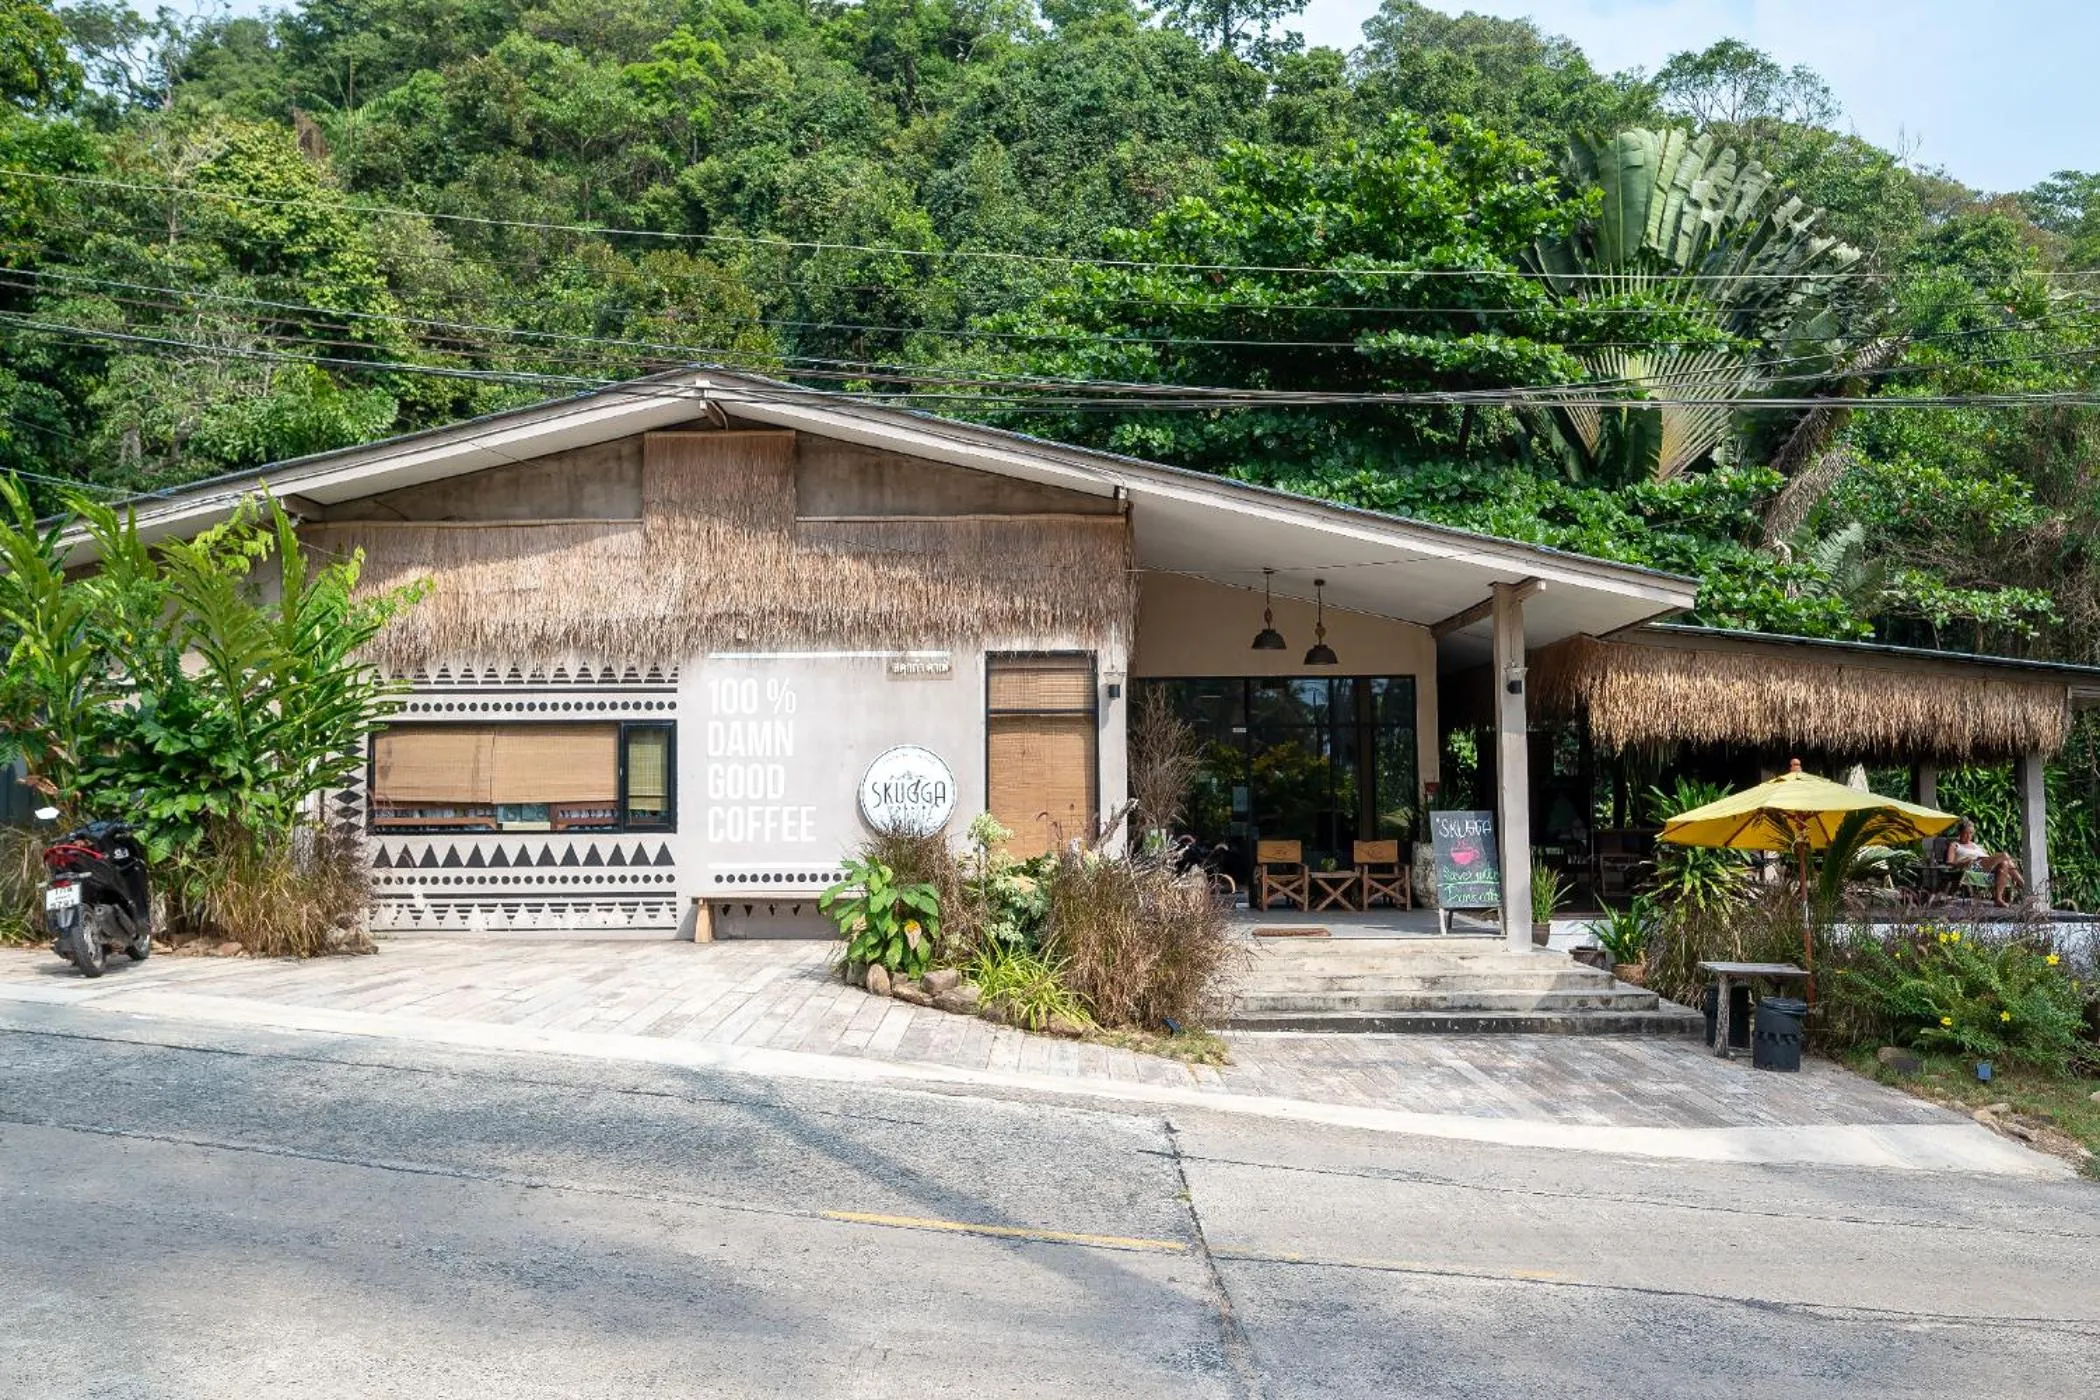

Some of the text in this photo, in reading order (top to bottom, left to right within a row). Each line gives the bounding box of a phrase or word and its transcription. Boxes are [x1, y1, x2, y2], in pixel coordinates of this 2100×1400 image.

[708, 677, 797, 715] 100 %
[707, 720, 794, 757] DAMN
[707, 763, 786, 800] GOOD
[871, 779, 946, 809] SKUGGA
[707, 805, 817, 843] COFFEE
